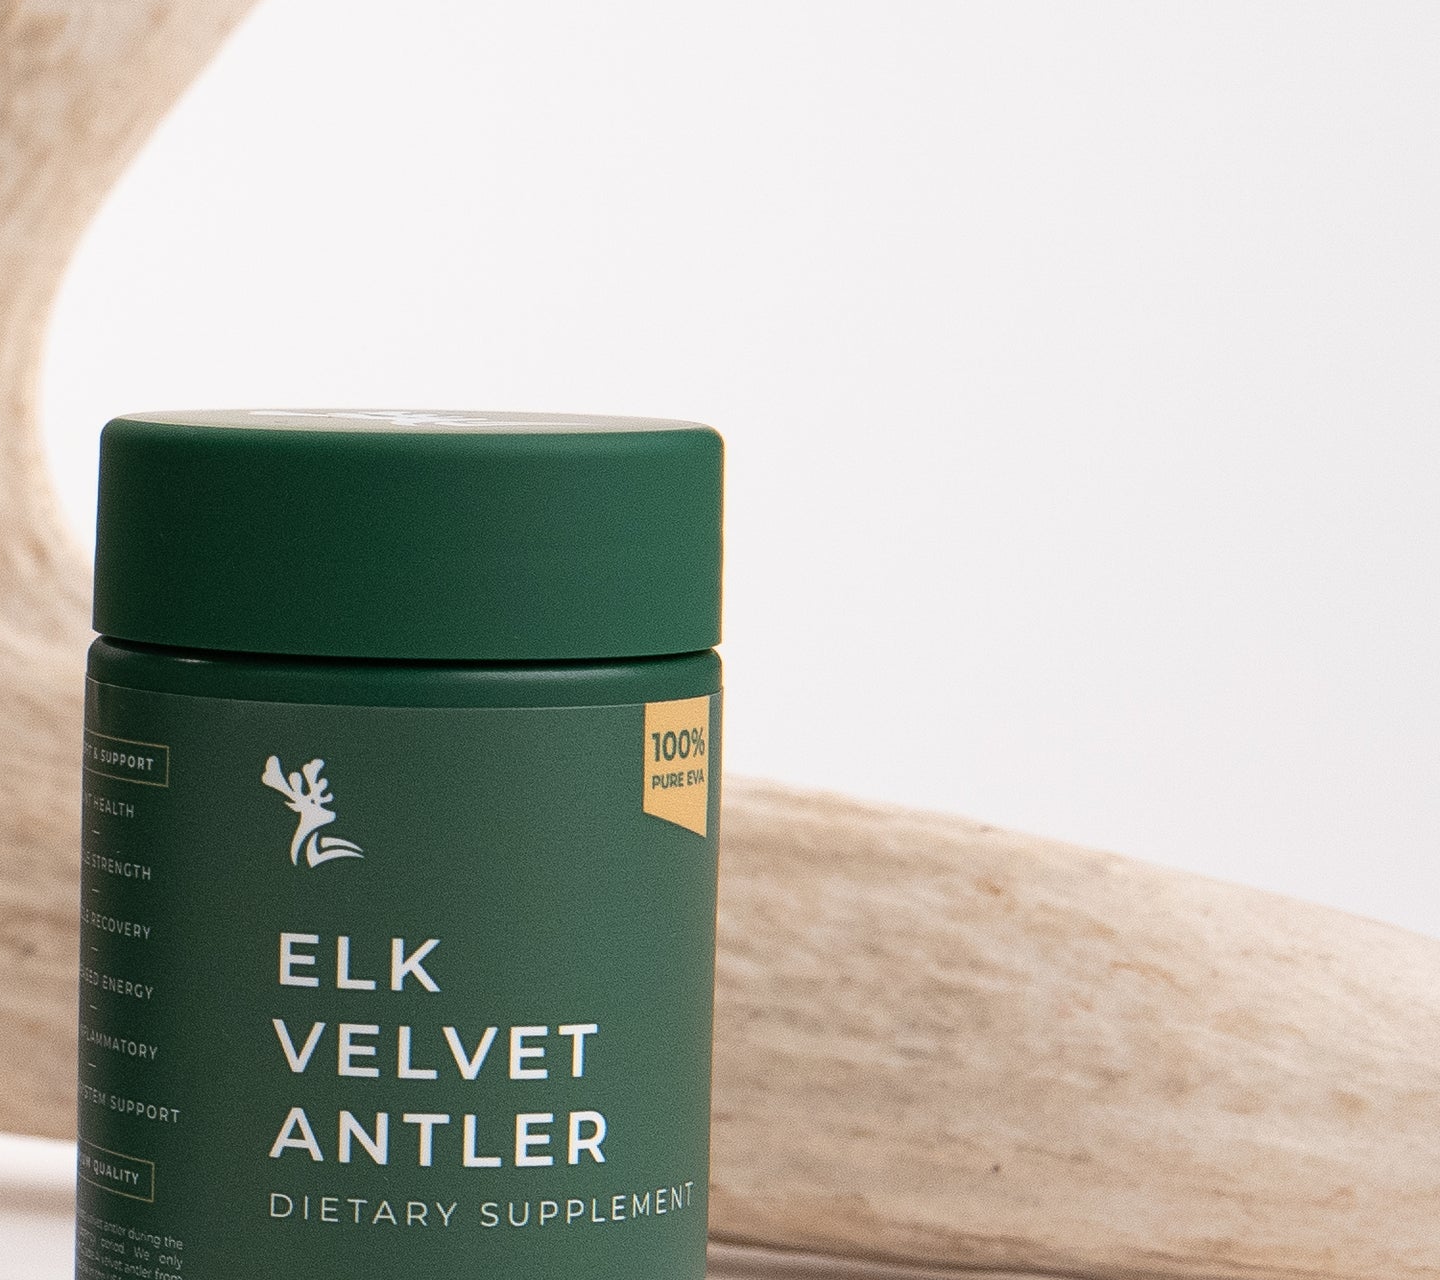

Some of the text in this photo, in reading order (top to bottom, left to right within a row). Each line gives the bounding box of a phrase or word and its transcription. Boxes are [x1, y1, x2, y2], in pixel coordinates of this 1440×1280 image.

[651, 726, 707, 763] 100%
[100, 749, 155, 771] SUPPORT
[651, 768, 706, 791] PURE EVA
[93, 794, 135, 819] HEALTH
[91, 852, 152, 881] STRENGTH
[90, 910, 152, 940] RECOVERY
[279, 932, 442, 993] ELK
[102, 974, 155, 1000] ENERGY
[271, 1018, 599, 1080] VELVET
[110, 1094, 181, 1123] SUPPORT
[268, 1106, 609, 1168] ANTLER
[93, 1158, 140, 1185] QUALITY
[269, 1180, 695, 1228] DIETARY SUPPLEMENT
[127, 1227, 161, 1249] during
[164, 1235, 184, 1251] the
[158, 1254, 184, 1271] only
